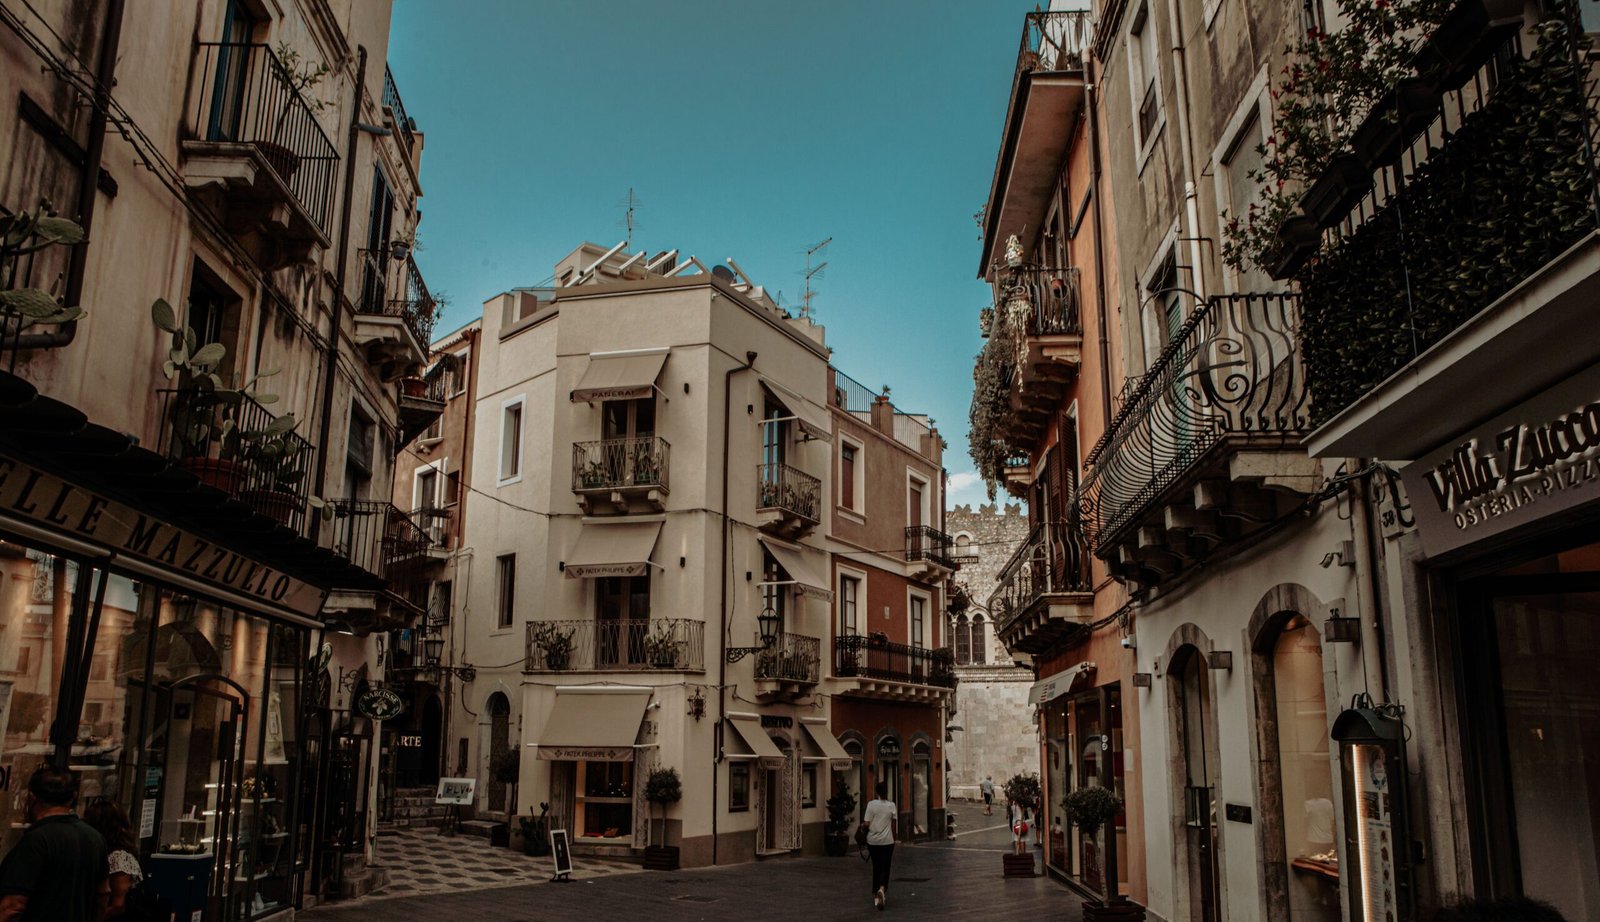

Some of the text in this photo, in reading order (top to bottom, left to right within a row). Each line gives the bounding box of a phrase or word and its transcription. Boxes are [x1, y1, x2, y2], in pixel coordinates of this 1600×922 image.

[1422, 442, 1504, 513] Villa
[1454, 484, 1535, 529] OSTERIA
[123, 515, 291, 602] MAZZULLO
[363, 690, 399, 704] NARCISSE
